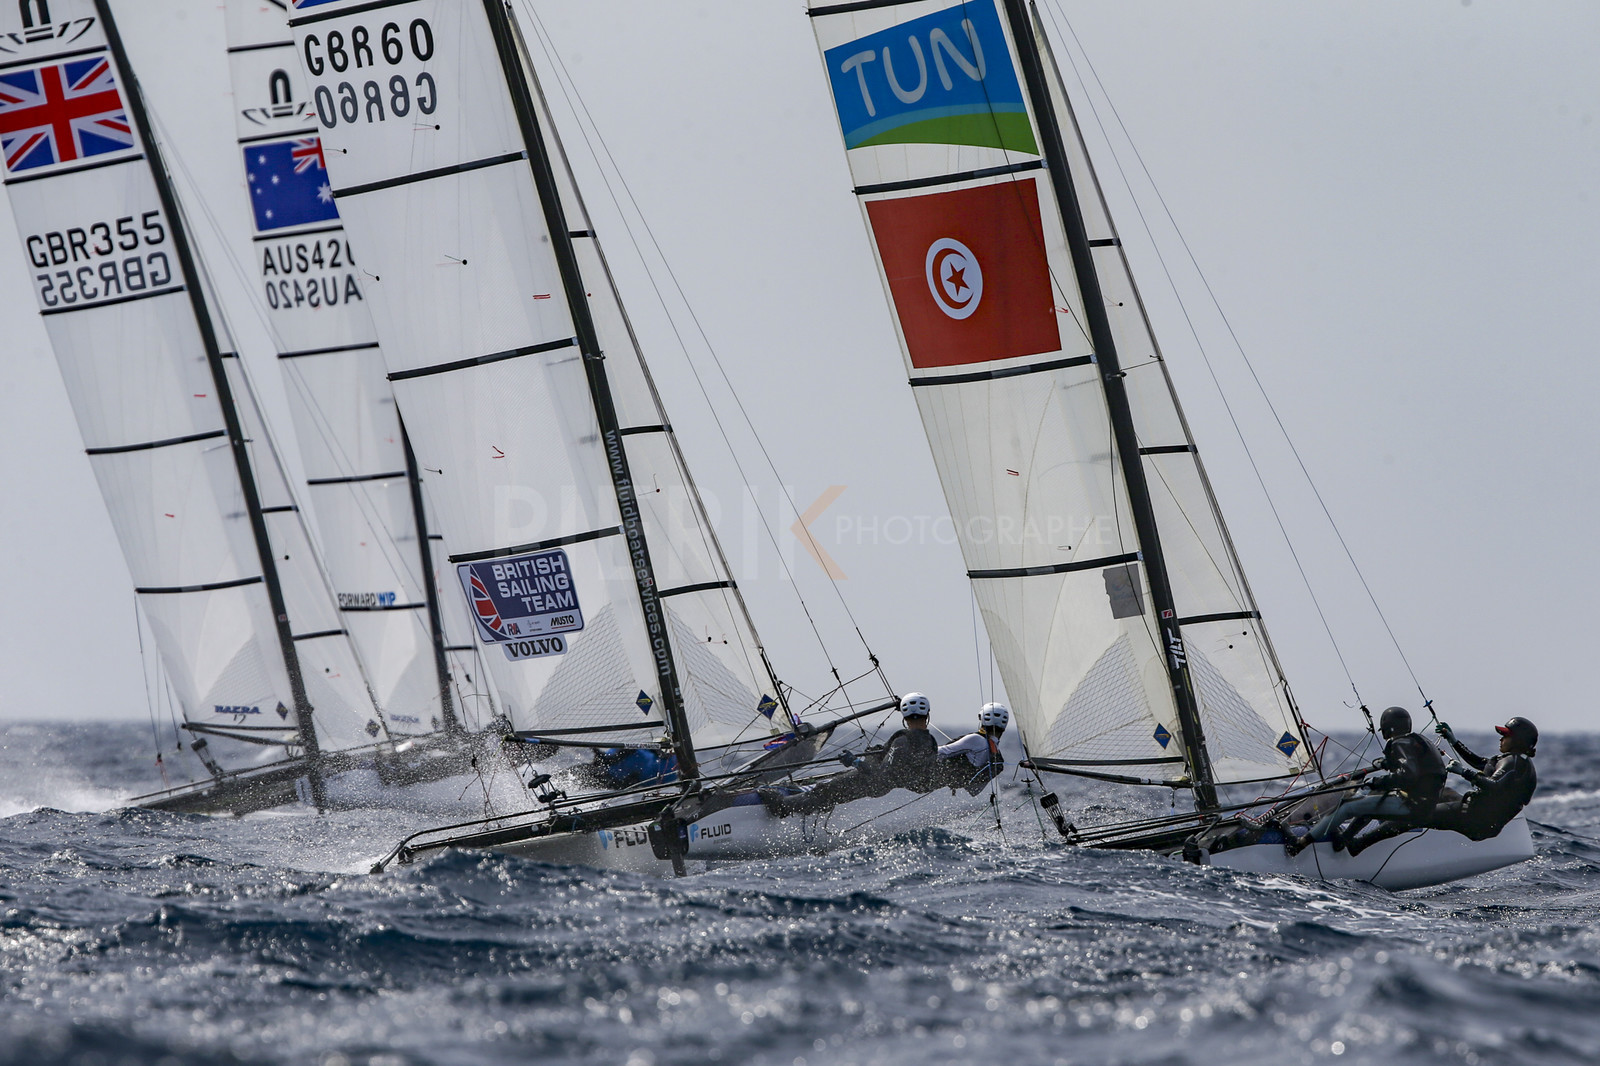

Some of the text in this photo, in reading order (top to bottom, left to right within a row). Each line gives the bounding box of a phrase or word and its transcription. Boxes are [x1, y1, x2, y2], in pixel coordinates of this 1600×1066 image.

[57, 17, 95, 45] 17
[304, 18, 434, 76] GBR60
[841, 18, 986, 117] TUN
[26, 210, 165, 268] GBR355
[492, 555, 565, 580] BRITISH
[497, 573, 569, 598] SAILING
[338, 592, 396, 606] FORWARD WIP
[521, 591, 574, 612] TEAM
[507, 622, 521, 635] RYA
[551, 615, 574, 626] MUSTO
[505, 637, 563, 657] VOLVO
[701, 823, 731, 840] FLUID
